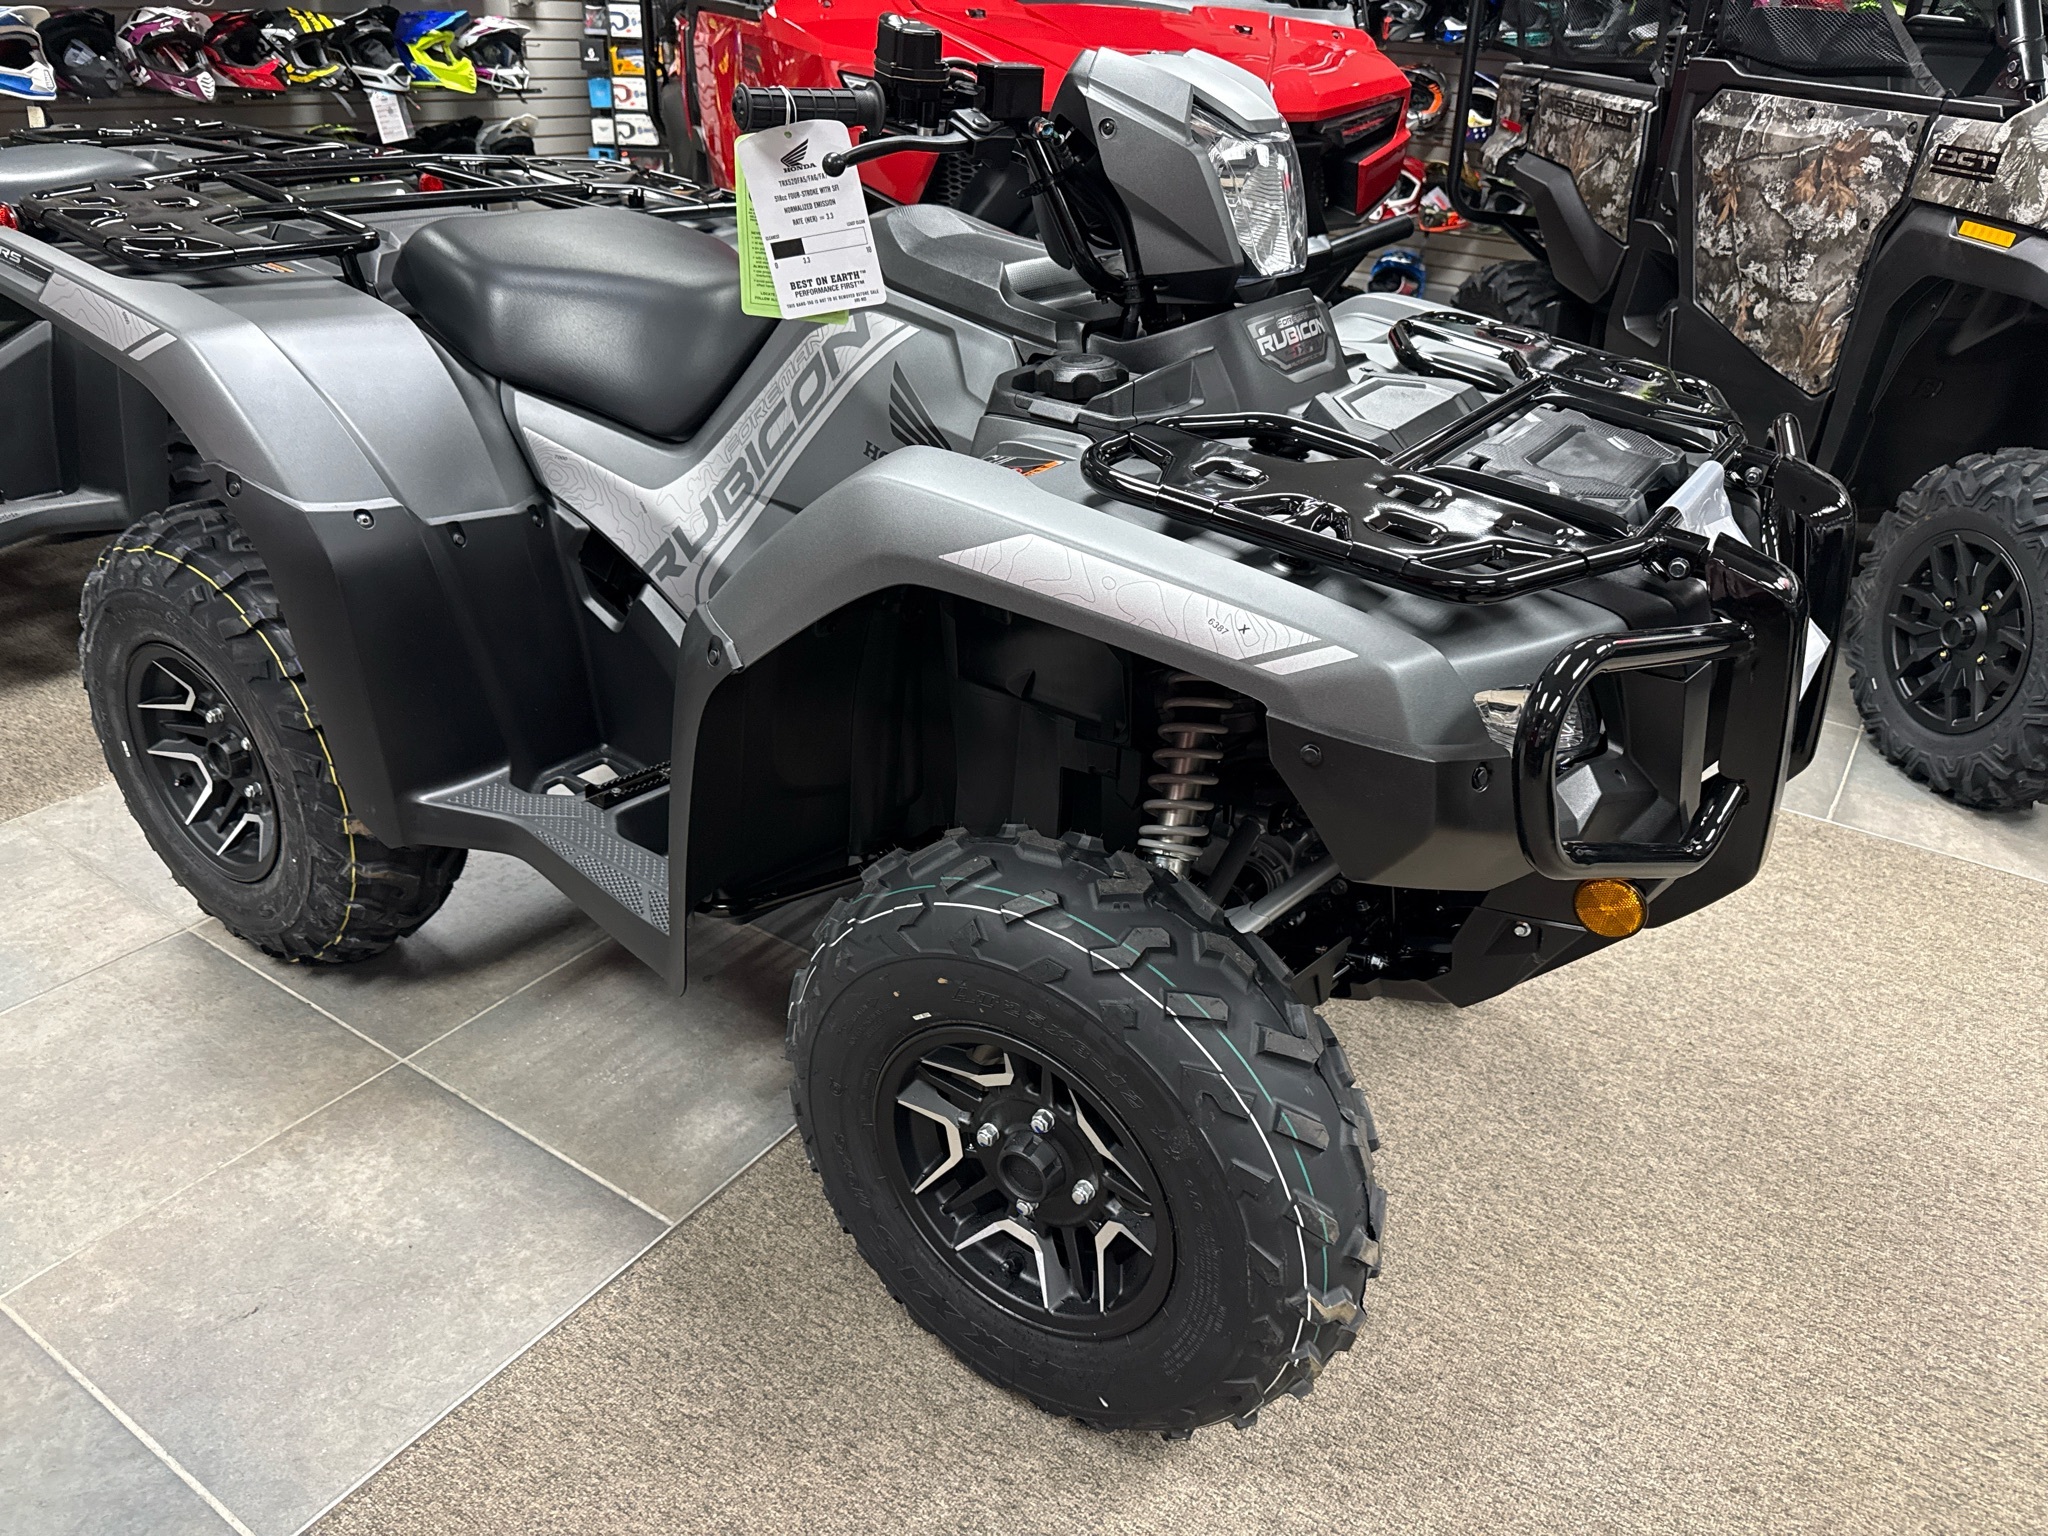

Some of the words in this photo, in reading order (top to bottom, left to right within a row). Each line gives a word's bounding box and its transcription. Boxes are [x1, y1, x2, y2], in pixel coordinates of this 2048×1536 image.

[1937, 148, 1997, 170] DCT
[783, 162, 817, 173] HONDA
[788, 187, 819, 199] FOUR-STROKE
[820, 185, 831, 194] WITH
[832, 183, 840, 192] SFI
[784, 202, 813, 214] NORMALIZED
[814, 198, 836, 209] EMISSION
[792, 217, 803, 226] RATE
[804, 215, 818, 225] (NER)
[826, 212, 834, 220] 3.3
[803, 256, 811, 264] 3.3
[789, 279, 814, 291] BEST
[816, 276, 828, 287] ON
[794, 284, 839, 299] PERFORMANCE
[1256, 317, 1326, 356] RUBICON
[723, 324, 827, 463] FOREMAN
[642, 312, 871, 582] RUBICON
[1207, 617, 1230, 635] 6387
